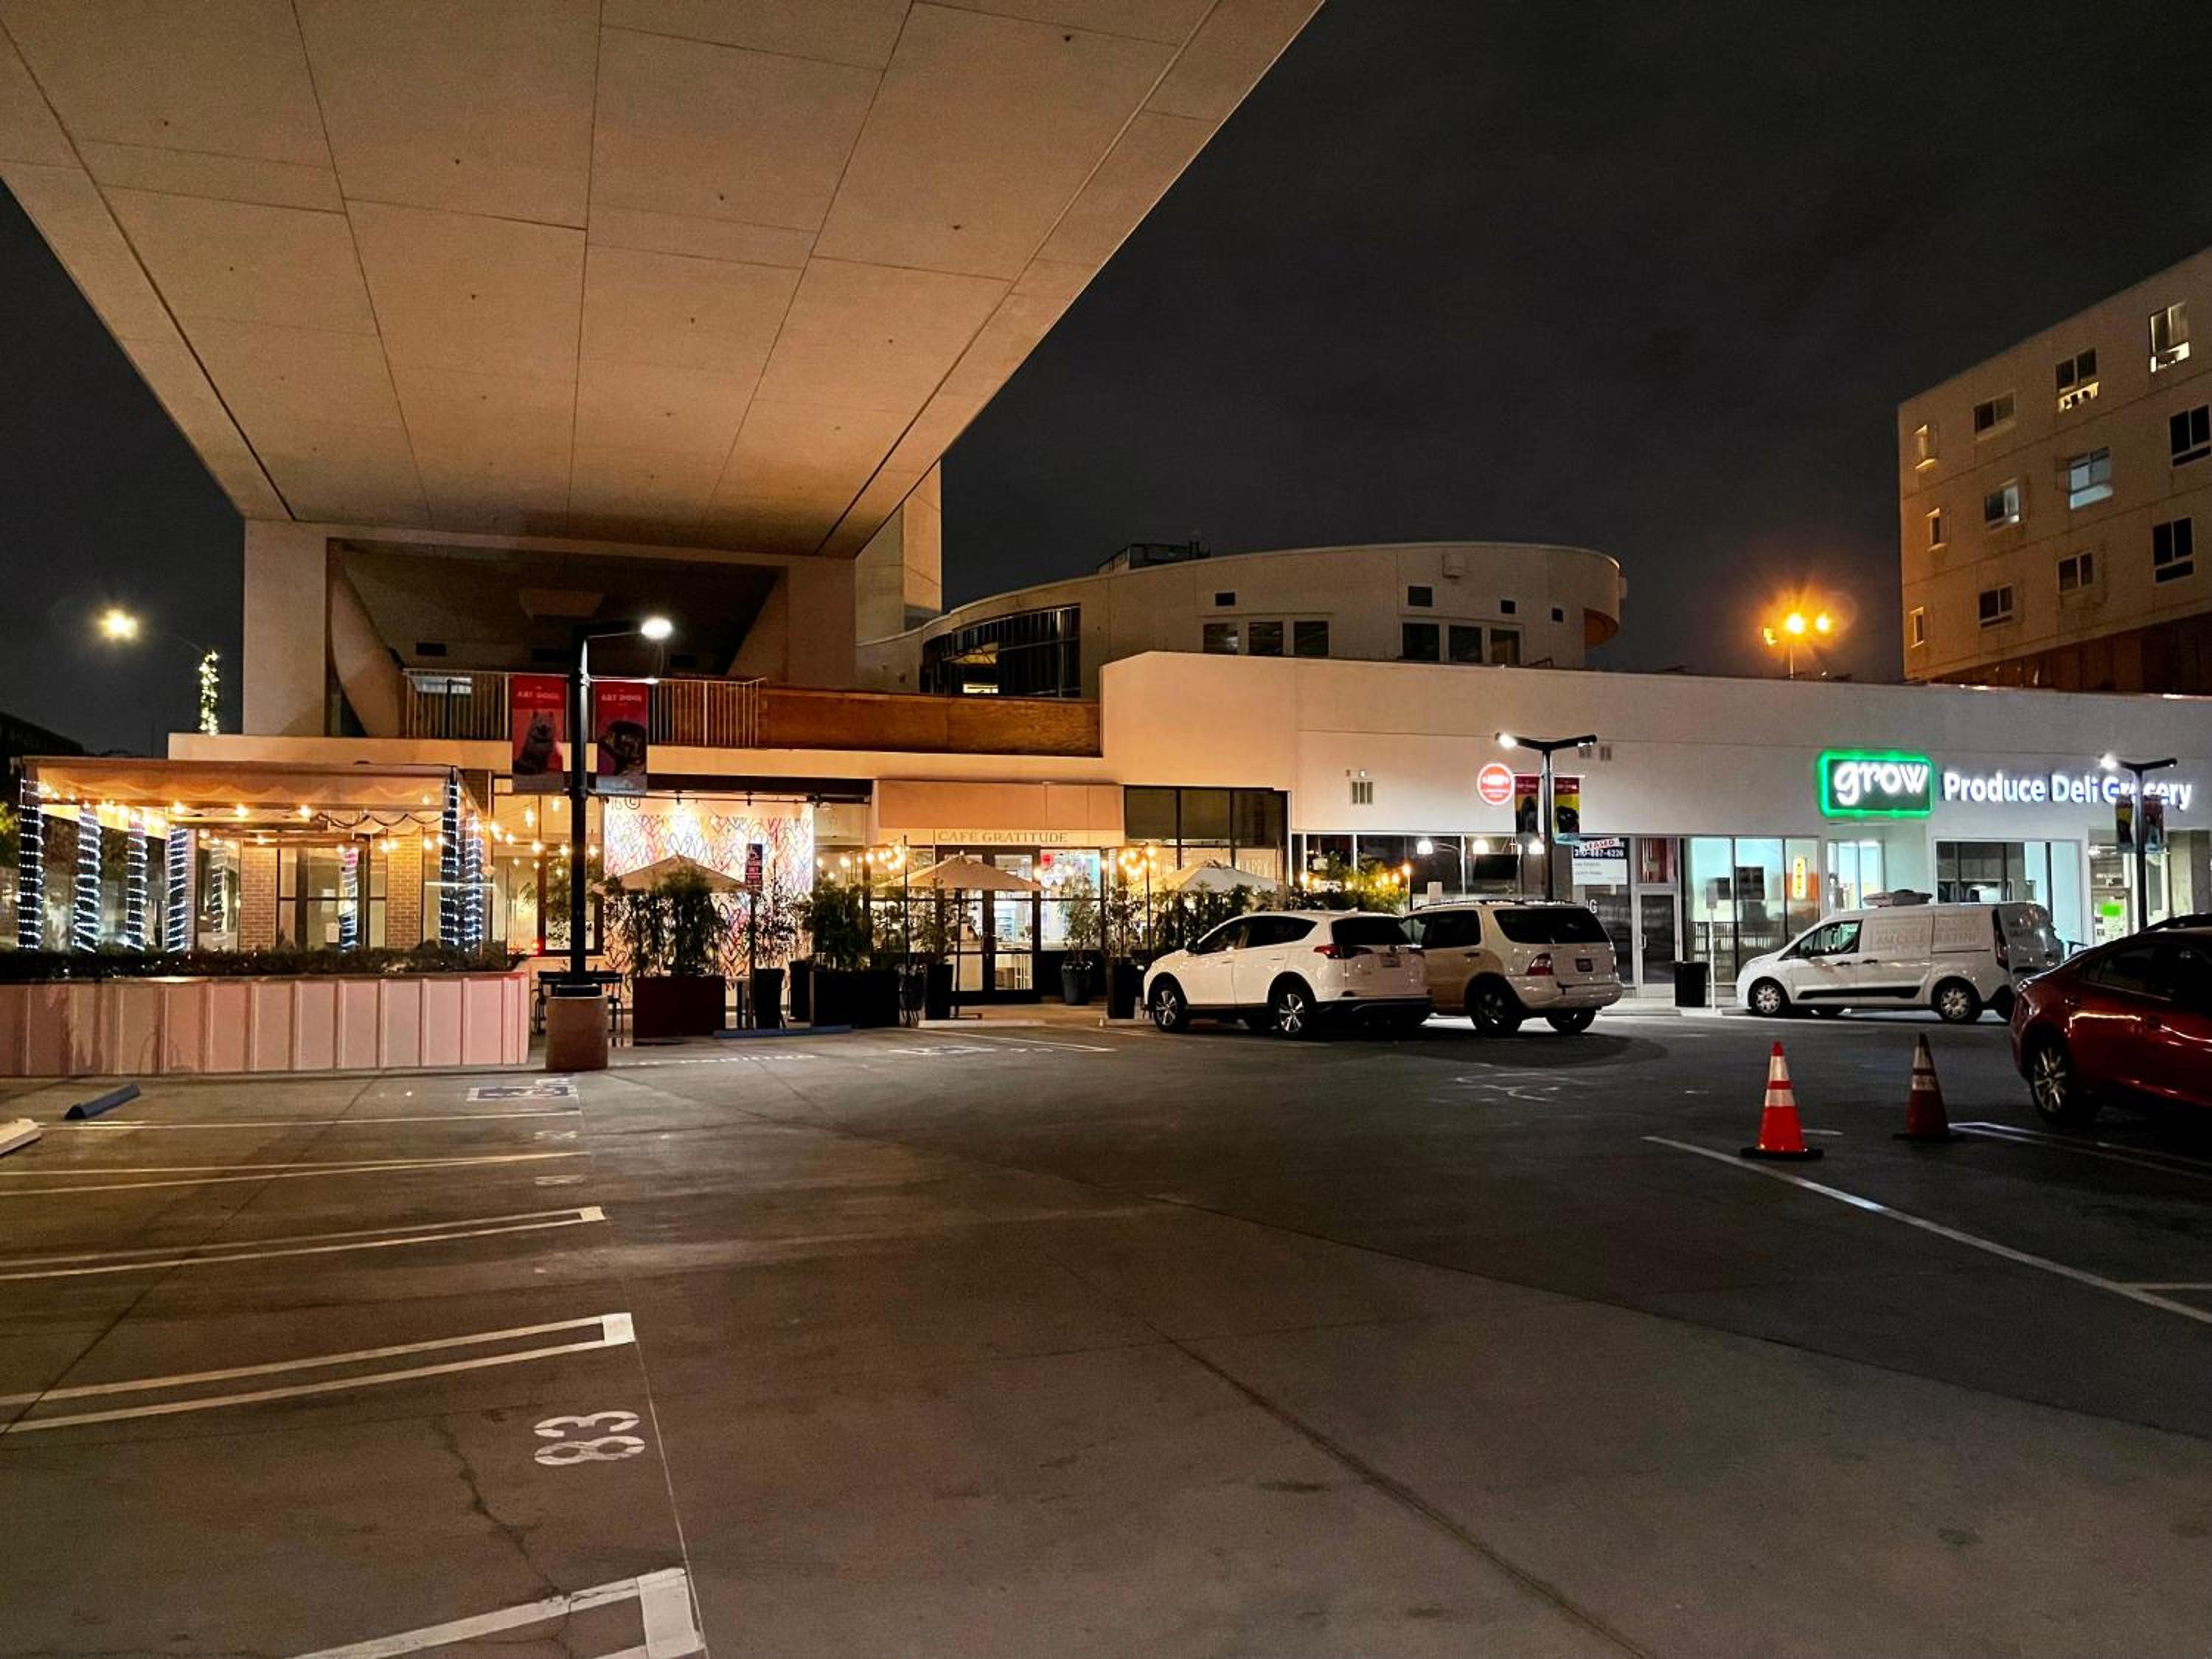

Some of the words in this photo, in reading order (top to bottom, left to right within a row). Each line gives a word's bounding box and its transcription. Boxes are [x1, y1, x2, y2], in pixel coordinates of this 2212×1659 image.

[1834, 762, 1929, 806] grow
[1943, 771, 2046, 803] Produce
[2052, 773, 2098, 803] Deli
[982, 832, 1068, 844] GRATITUDE
[1585, 839, 1615, 849] LEASED
[534, 1411, 646, 1466] 83
